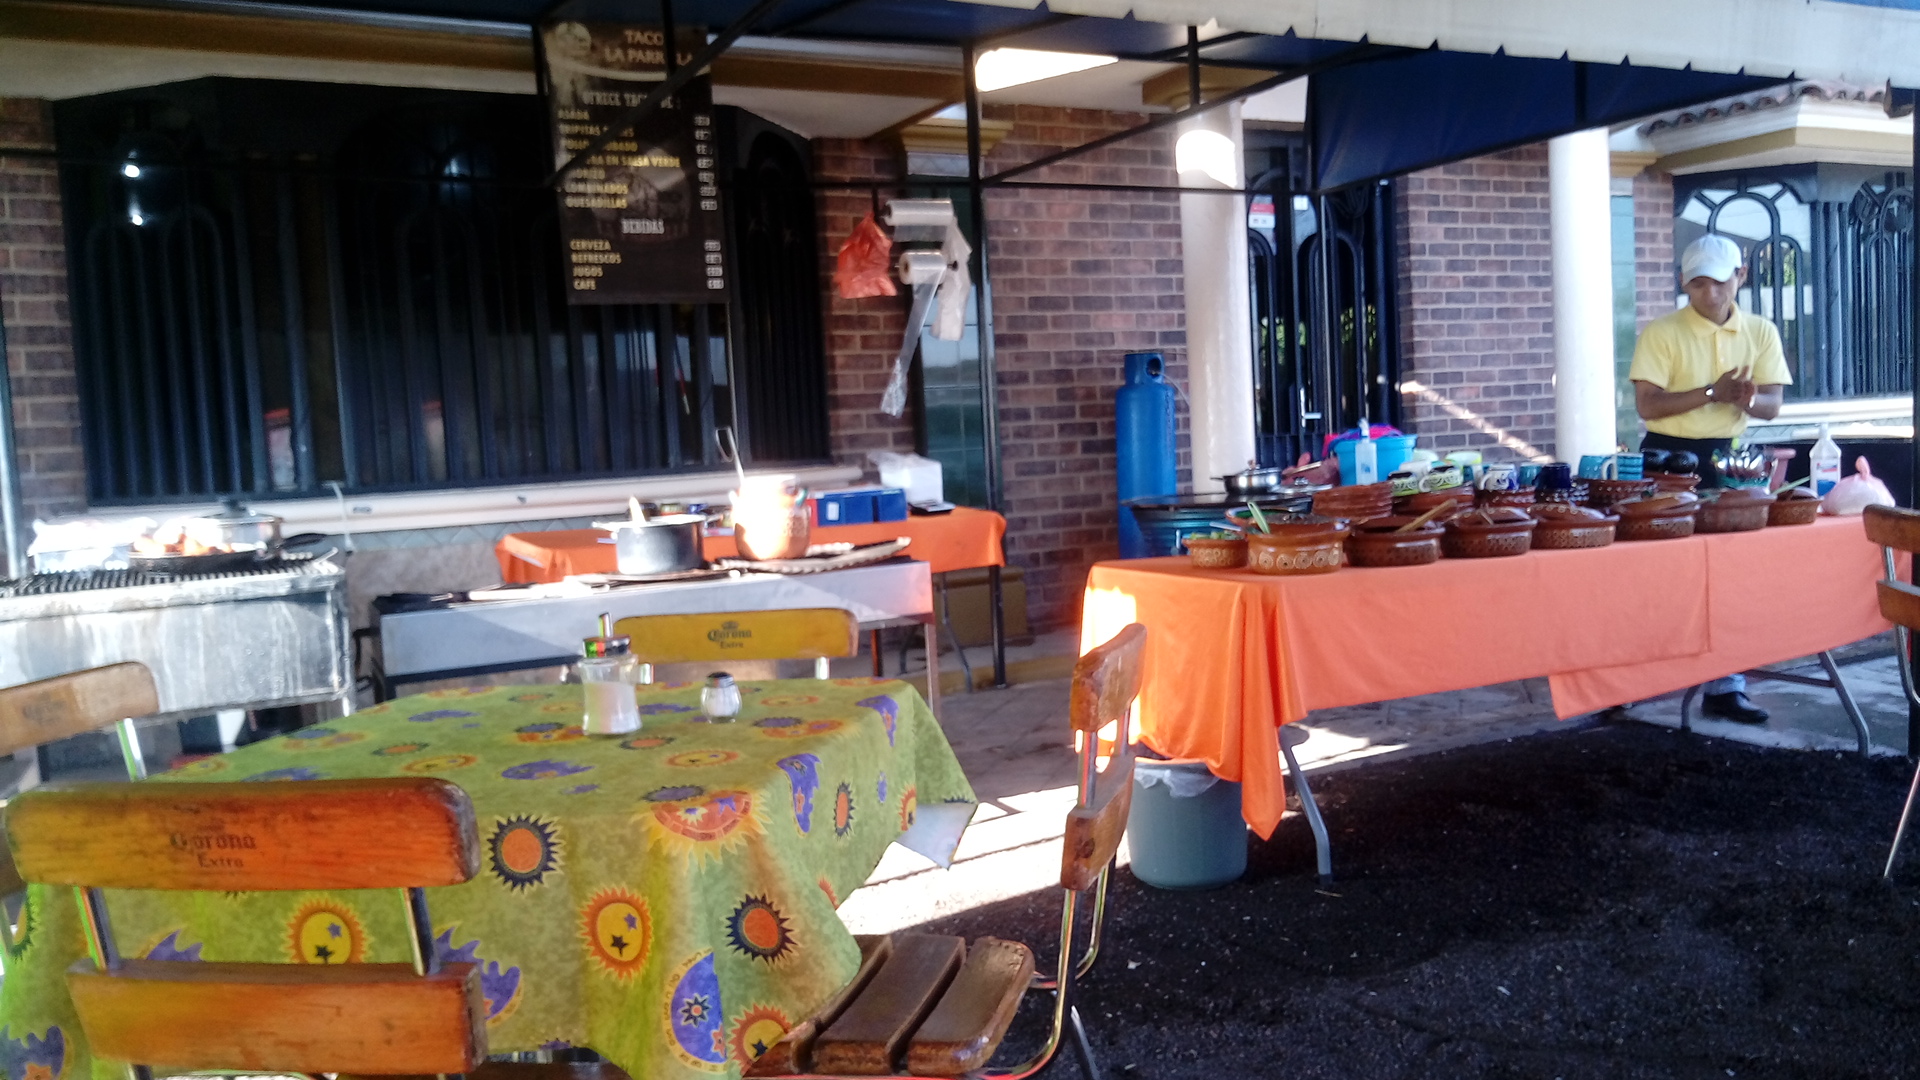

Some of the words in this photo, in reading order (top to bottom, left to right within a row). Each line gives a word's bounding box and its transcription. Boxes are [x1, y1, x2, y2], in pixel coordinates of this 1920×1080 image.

[624, 29, 665, 46] TACO
[603, 47, 626, 63] LA
[620, 218, 665, 235] BEBIDAS
[569, 238, 612, 251] CERVEZA
[570, 252, 623, 265] REFRESCOS
[572, 265, 604, 278] JUGOS
[572, 278, 597, 291] CAFE
[707, 629, 752, 642] Corona
[169, 831, 258, 855] Corona
